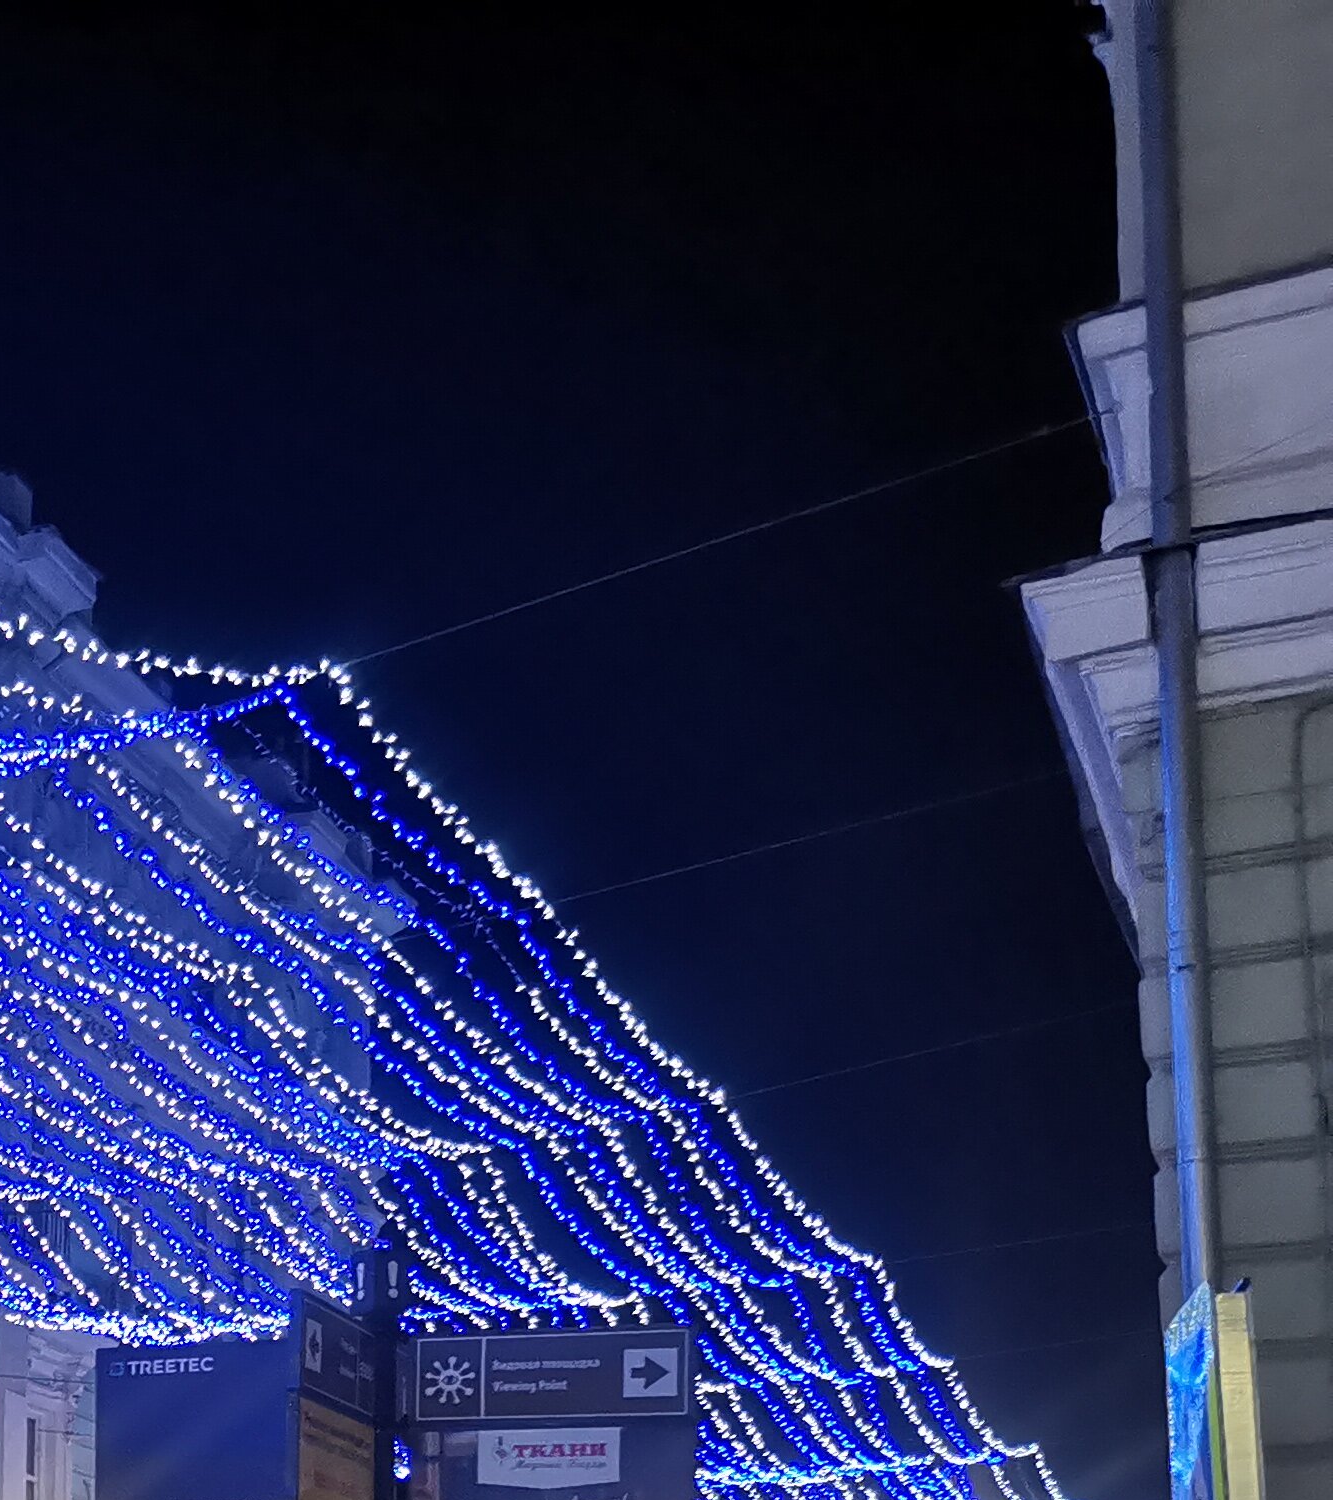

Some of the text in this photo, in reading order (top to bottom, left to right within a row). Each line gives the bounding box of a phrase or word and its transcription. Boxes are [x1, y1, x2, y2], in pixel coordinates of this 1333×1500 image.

[127, 1356, 215, 1375] TREETEC
[492, 1379, 568, 1394] Viewing Point
[512, 1443, 608, 1458] ТКАНИ
